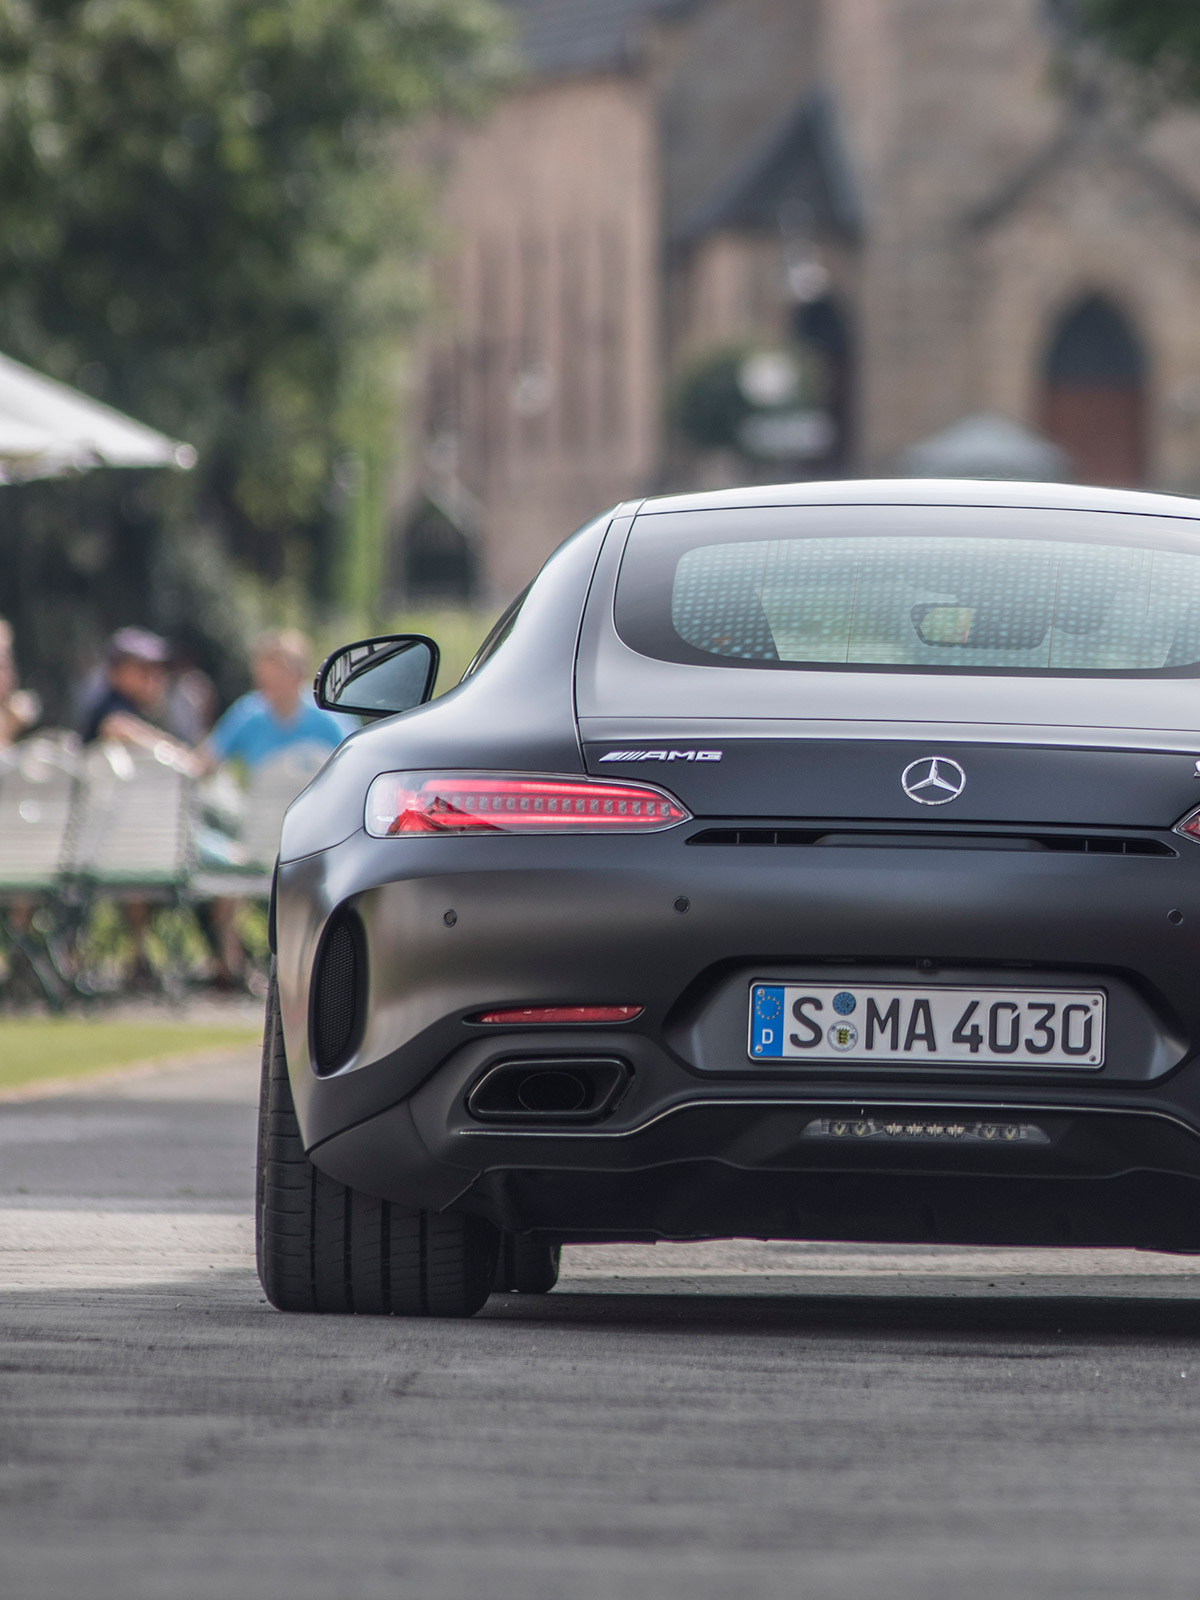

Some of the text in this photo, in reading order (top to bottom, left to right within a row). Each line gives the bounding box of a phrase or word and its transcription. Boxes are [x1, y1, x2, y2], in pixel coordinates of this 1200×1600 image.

[637, 750, 723, 762] AMG
[761, 1029, 774, 1045] D
[789, 996, 823, 1049] S
[864, 997, 937, 1052] MA
[951, 1000, 1093, 1056] 4030
